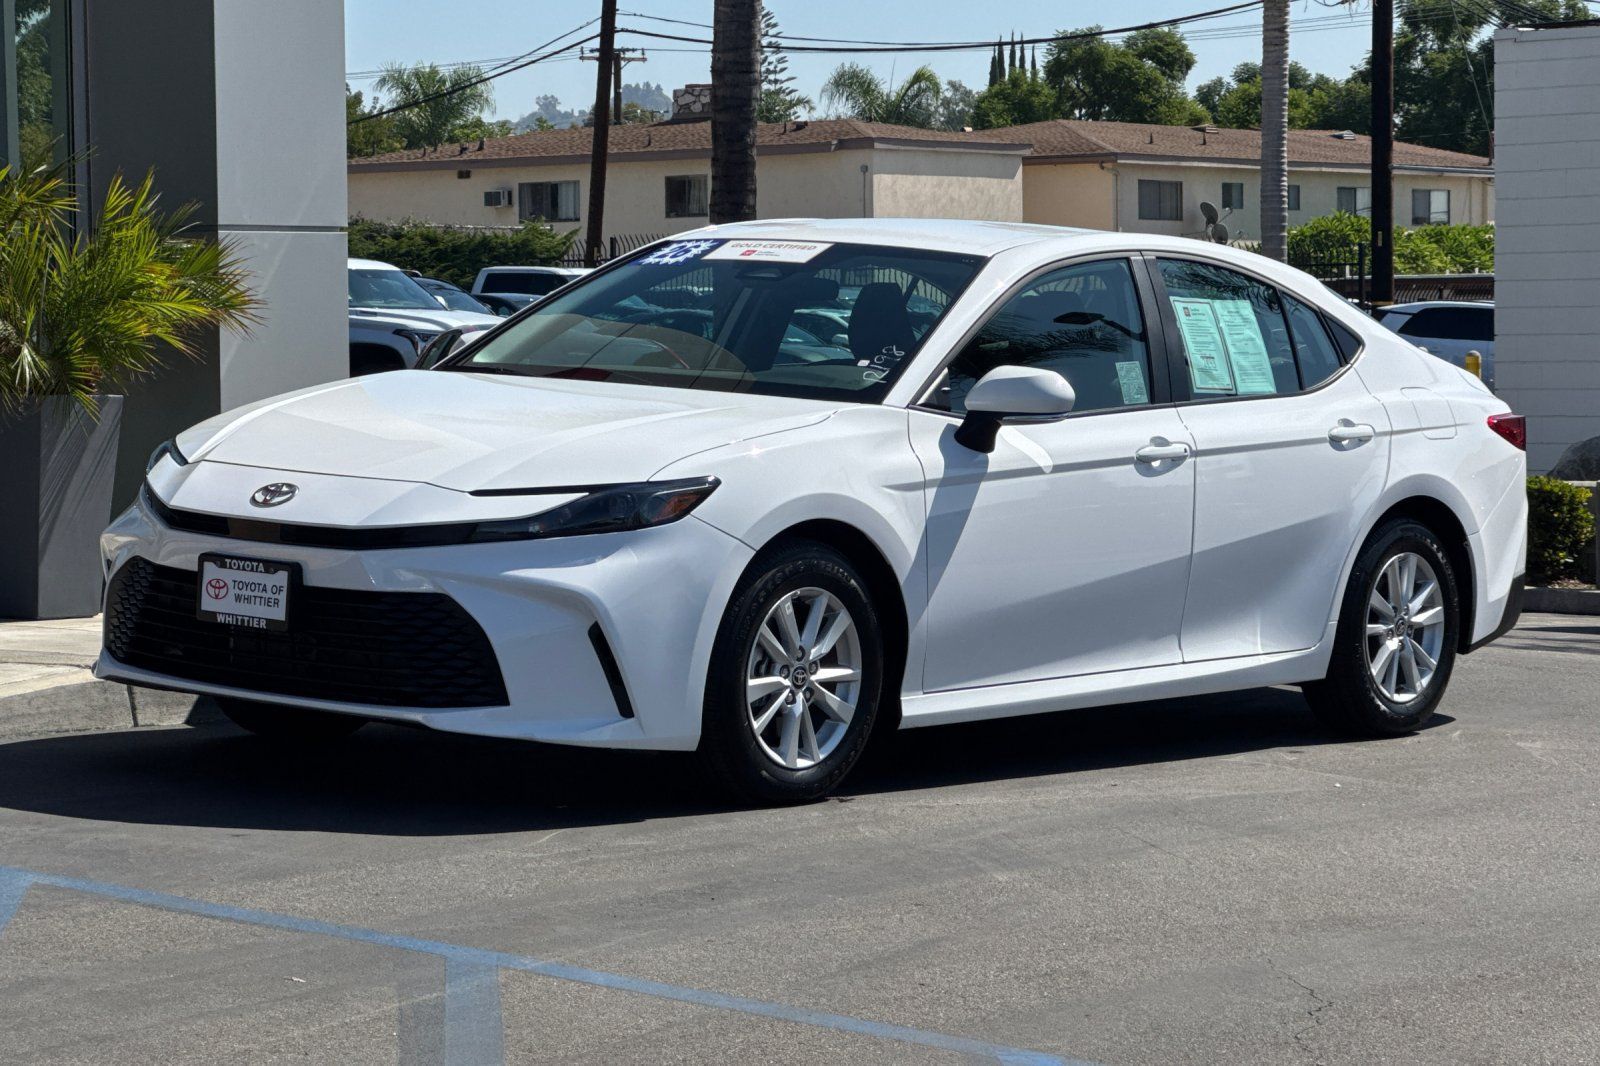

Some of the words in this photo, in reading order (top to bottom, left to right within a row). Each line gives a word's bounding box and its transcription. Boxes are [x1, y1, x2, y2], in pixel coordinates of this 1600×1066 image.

[763, 243, 818, 251] CERTIFIED
[225, 559, 265, 572] TOYOTA
[232, 580, 267, 593] TOYOTA
[270, 585, 284, 595] OF
[234, 594, 279, 608] WHITTIER
[217, 613, 267, 629] WHITTIER
